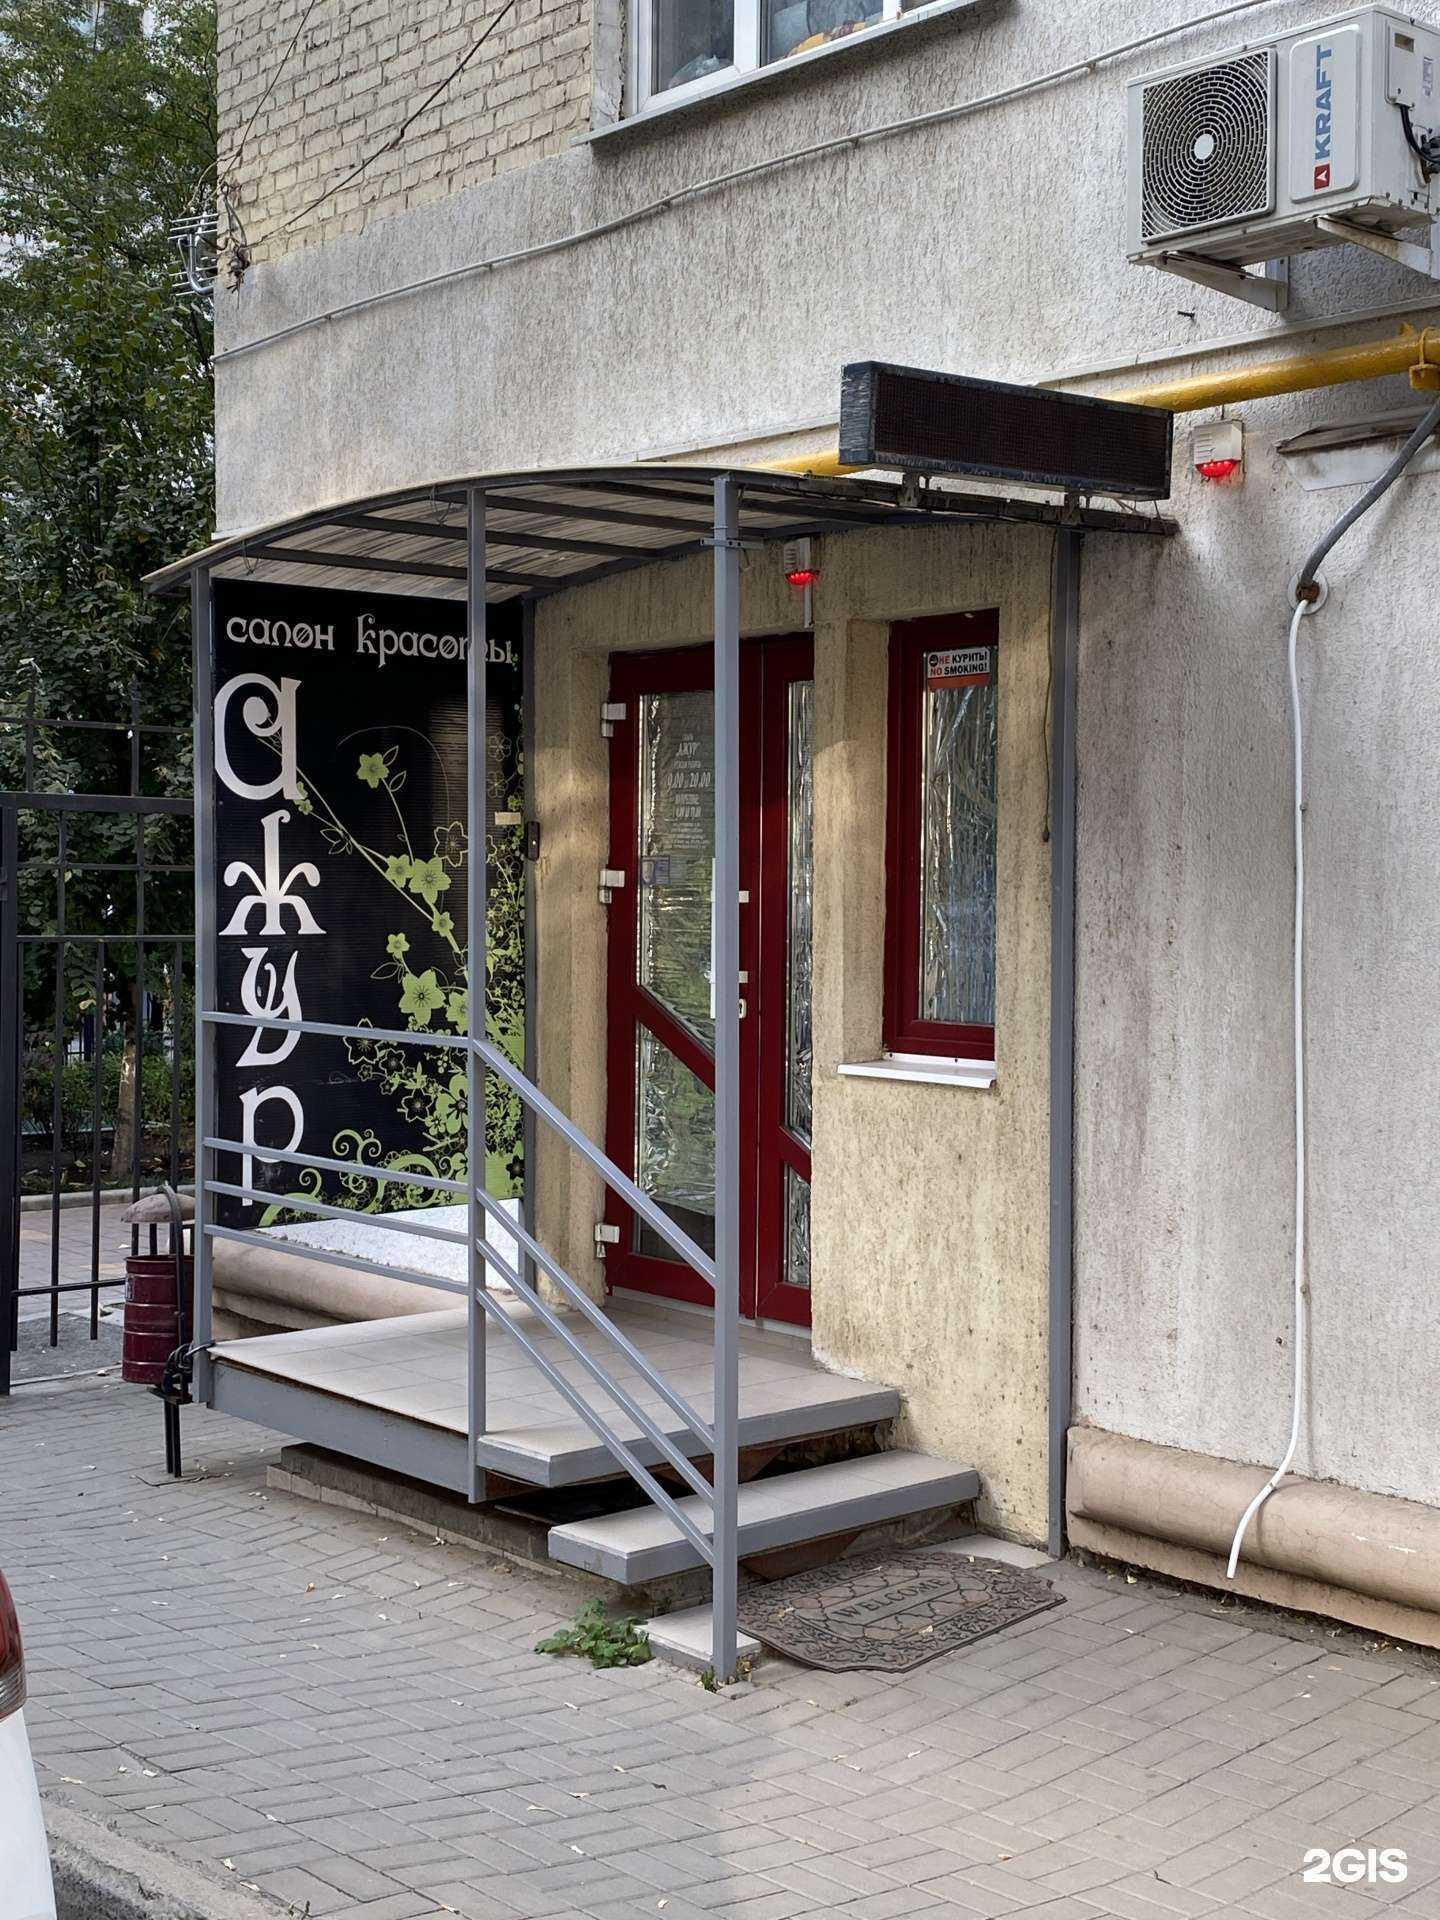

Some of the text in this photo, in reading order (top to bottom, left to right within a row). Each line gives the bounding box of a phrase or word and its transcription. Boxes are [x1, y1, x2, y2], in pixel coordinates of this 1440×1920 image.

[1314, 45, 1333, 160] KRAFT
[226, 616, 335, 650] салон
[930, 662, 988, 676] NO SMOKING!
[938, 651, 988, 665] НЕ КУРИТЬ!
[831, 1578, 951, 1618] WELCOME
